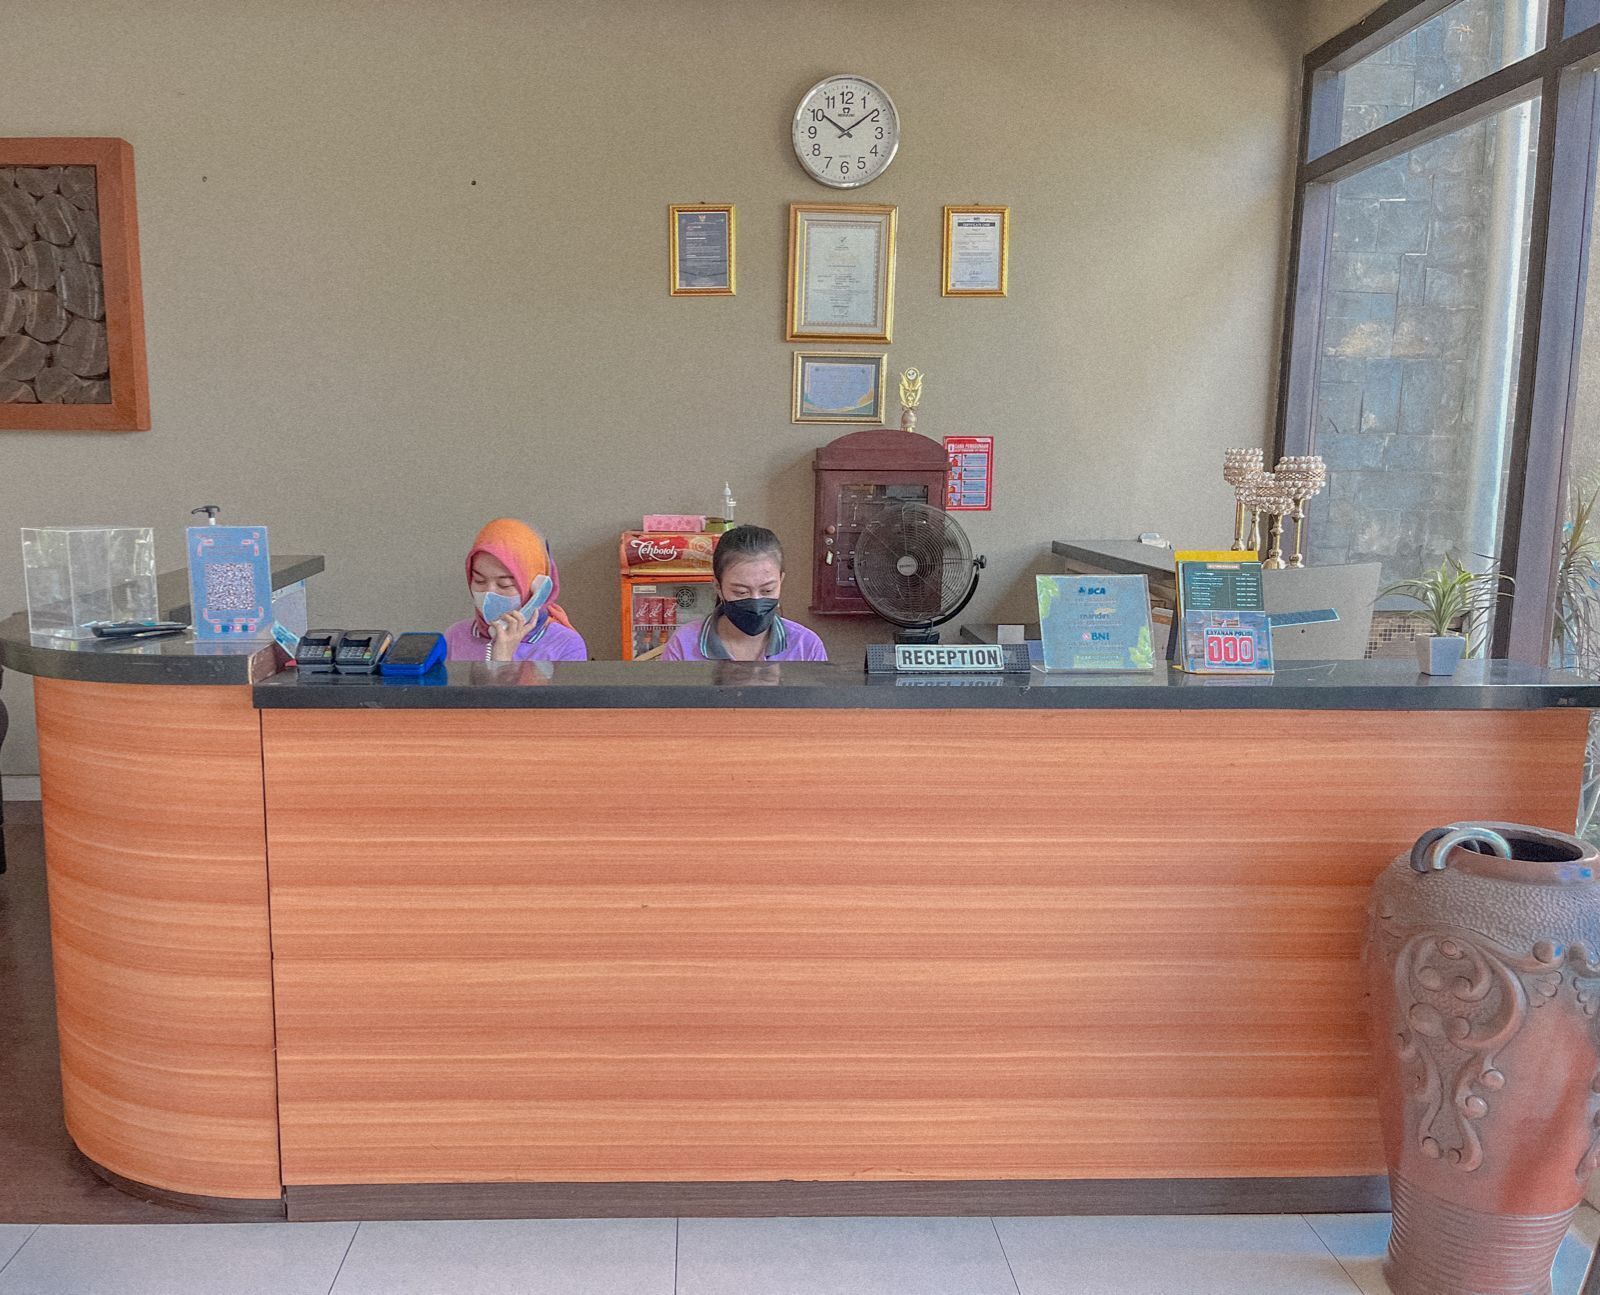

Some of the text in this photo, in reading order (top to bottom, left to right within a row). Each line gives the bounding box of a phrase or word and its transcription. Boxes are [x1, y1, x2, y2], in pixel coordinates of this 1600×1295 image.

[825, 96, 835, 109] 11
[840, 91, 854, 105] 12
[861, 96, 866, 109] 1
[811, 109, 825, 122] 10
[871, 108, 880, 122] 2
[808, 126, 817, 139] 9
[874, 127, 884, 140] 3
[812, 143, 821, 156] 8
[869, 144, 879, 157] 4
[824, 156, 833, 169] 7
[840, 161, 849, 174] 6
[857, 157, 866, 170] 5
[1087, 587, 1106, 595] BCA
[1091, 632, 1110, 641] BNI
[1208, 637, 1253, 661] 110
[902, 649, 998, 665] RECEPTION
